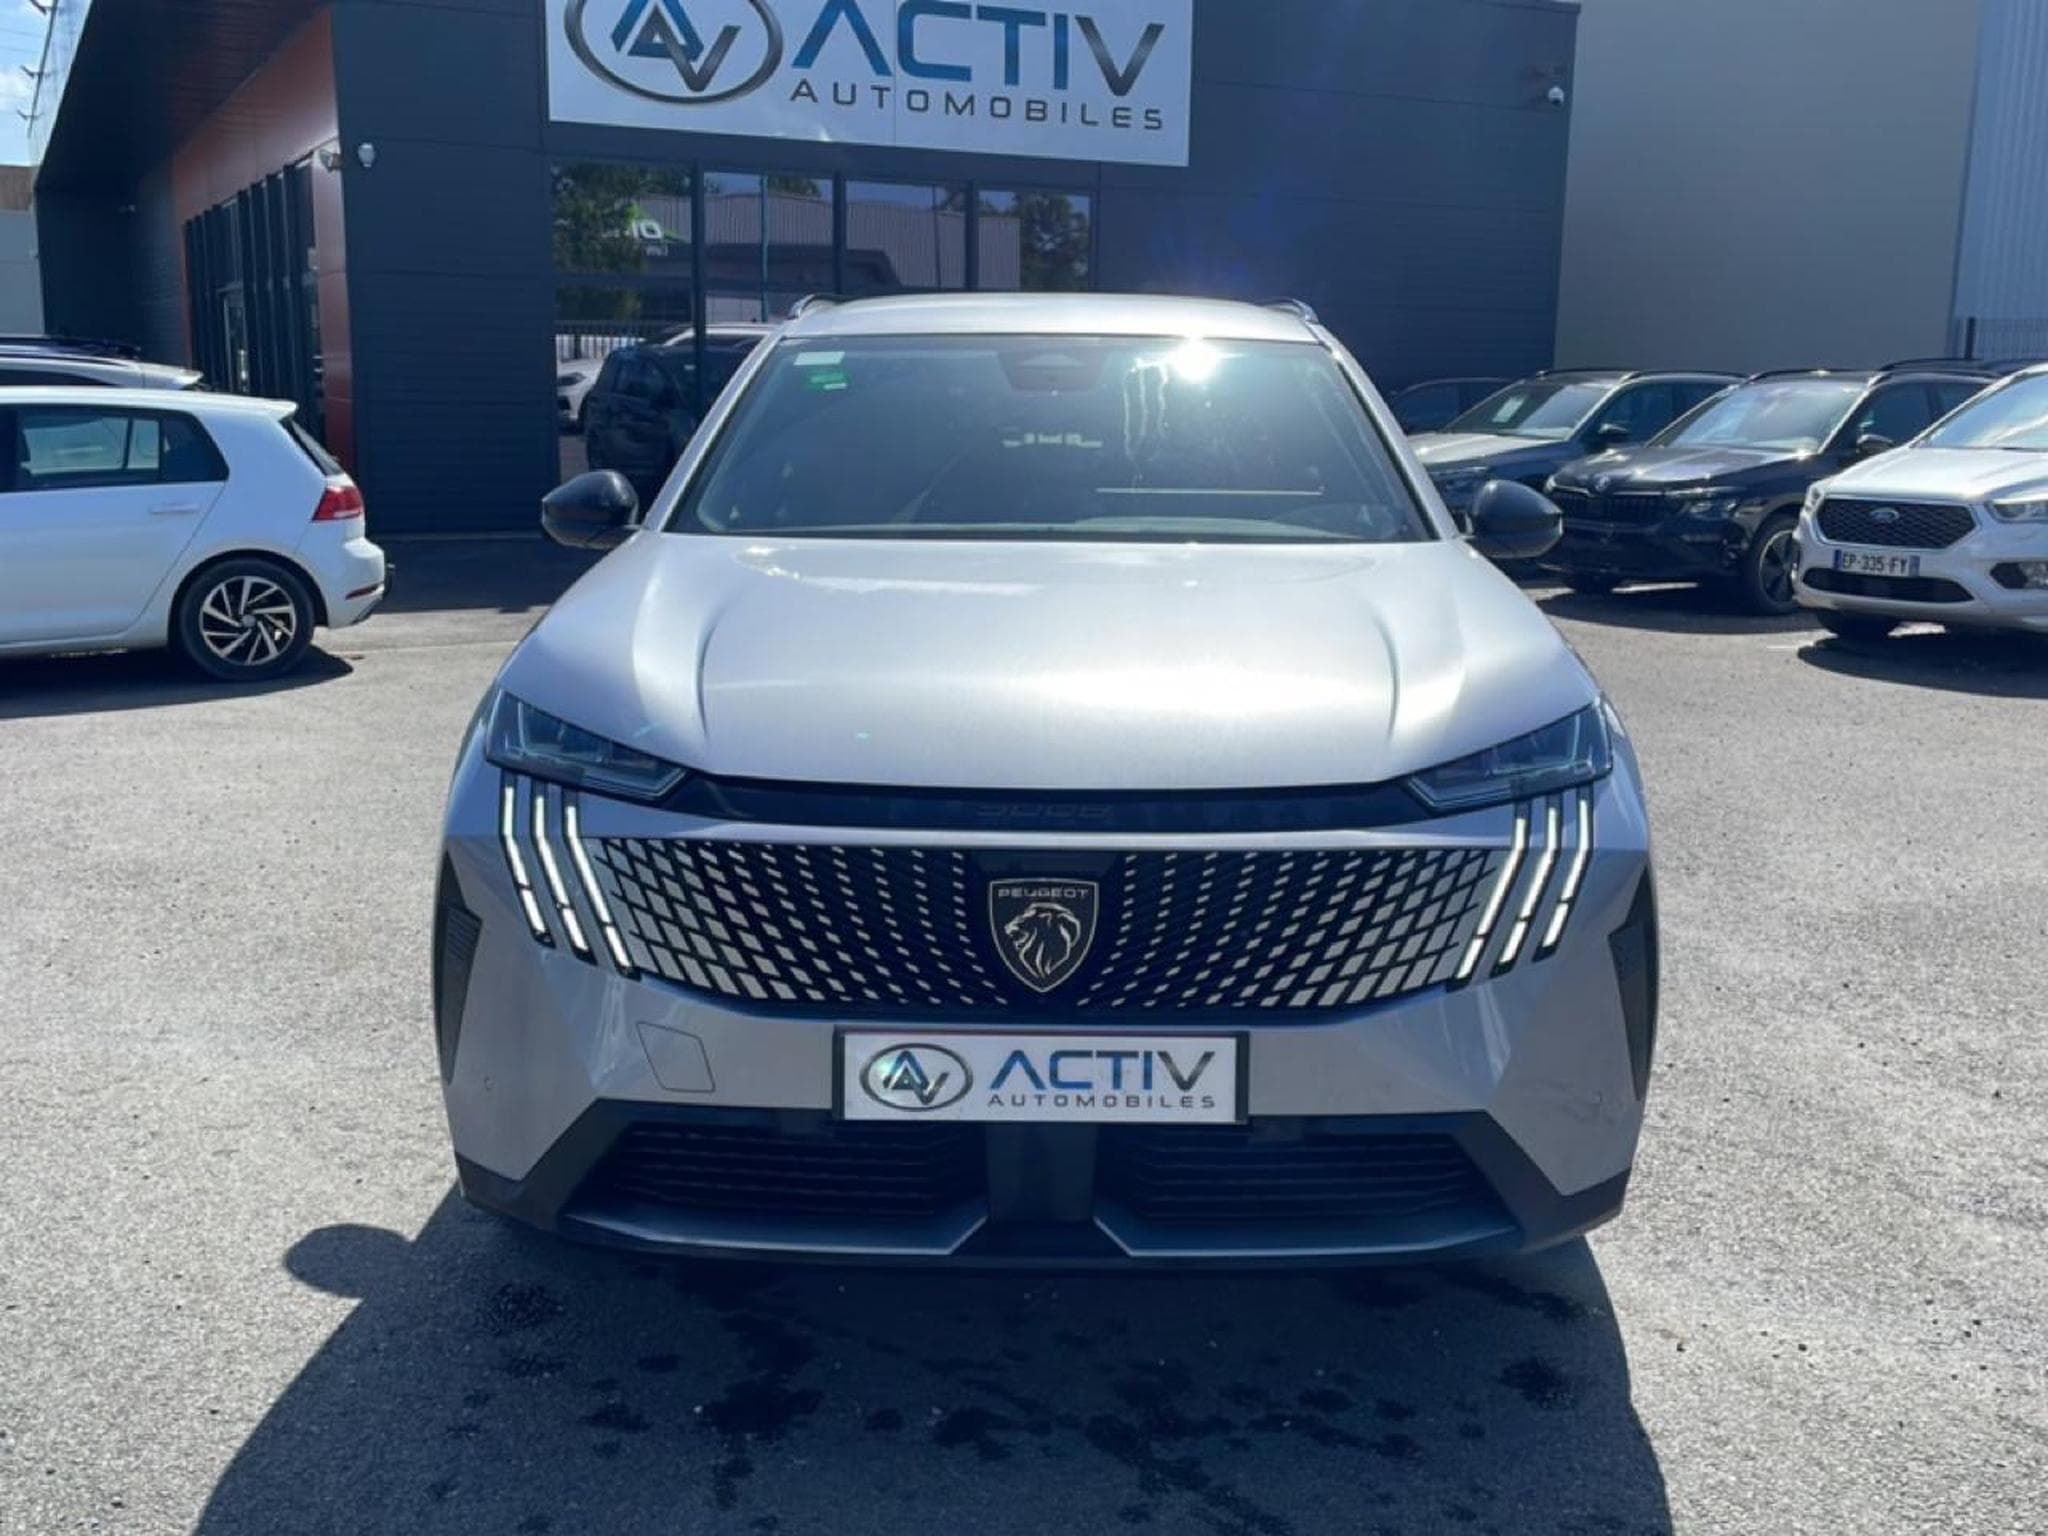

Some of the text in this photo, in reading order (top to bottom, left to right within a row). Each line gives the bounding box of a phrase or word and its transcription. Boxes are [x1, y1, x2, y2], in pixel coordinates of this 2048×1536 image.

[791, 0, 1165, 97] ACTIV
[790, 78, 1163, 130] AUTOMOBILES
[998, 887, 1088, 898] PEUGEOT
[990, 1050, 1216, 1092] ACTIV
[987, 1093, 1216, 1109] AUTOMOBILES
